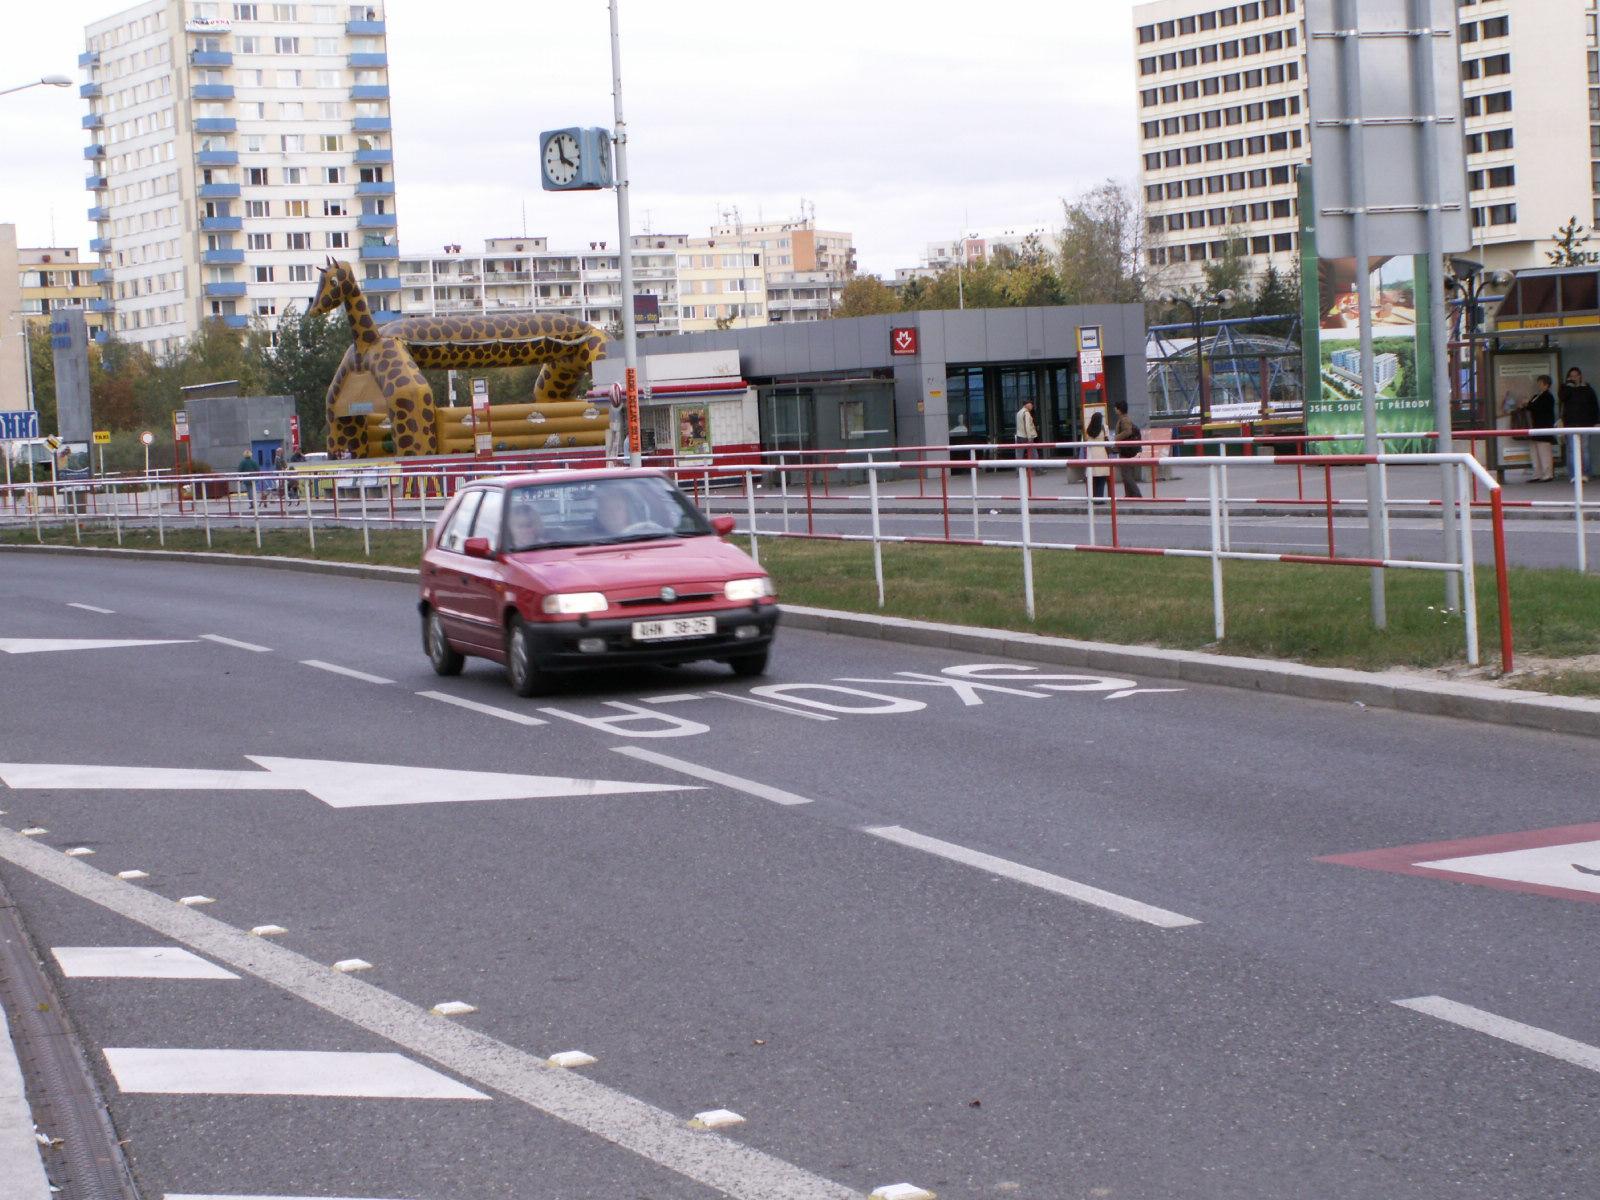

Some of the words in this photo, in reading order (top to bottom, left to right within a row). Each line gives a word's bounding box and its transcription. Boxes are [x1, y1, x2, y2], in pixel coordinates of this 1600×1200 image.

[626, 368, 635, 392] RADIO
[628, 395, 637, 422] DEEJAY
[1309, 404, 1333, 413] JSME
[1337, 401, 1384, 412] SOUČTÍ
[1388, 399, 1430, 410] PŘÍRODY
